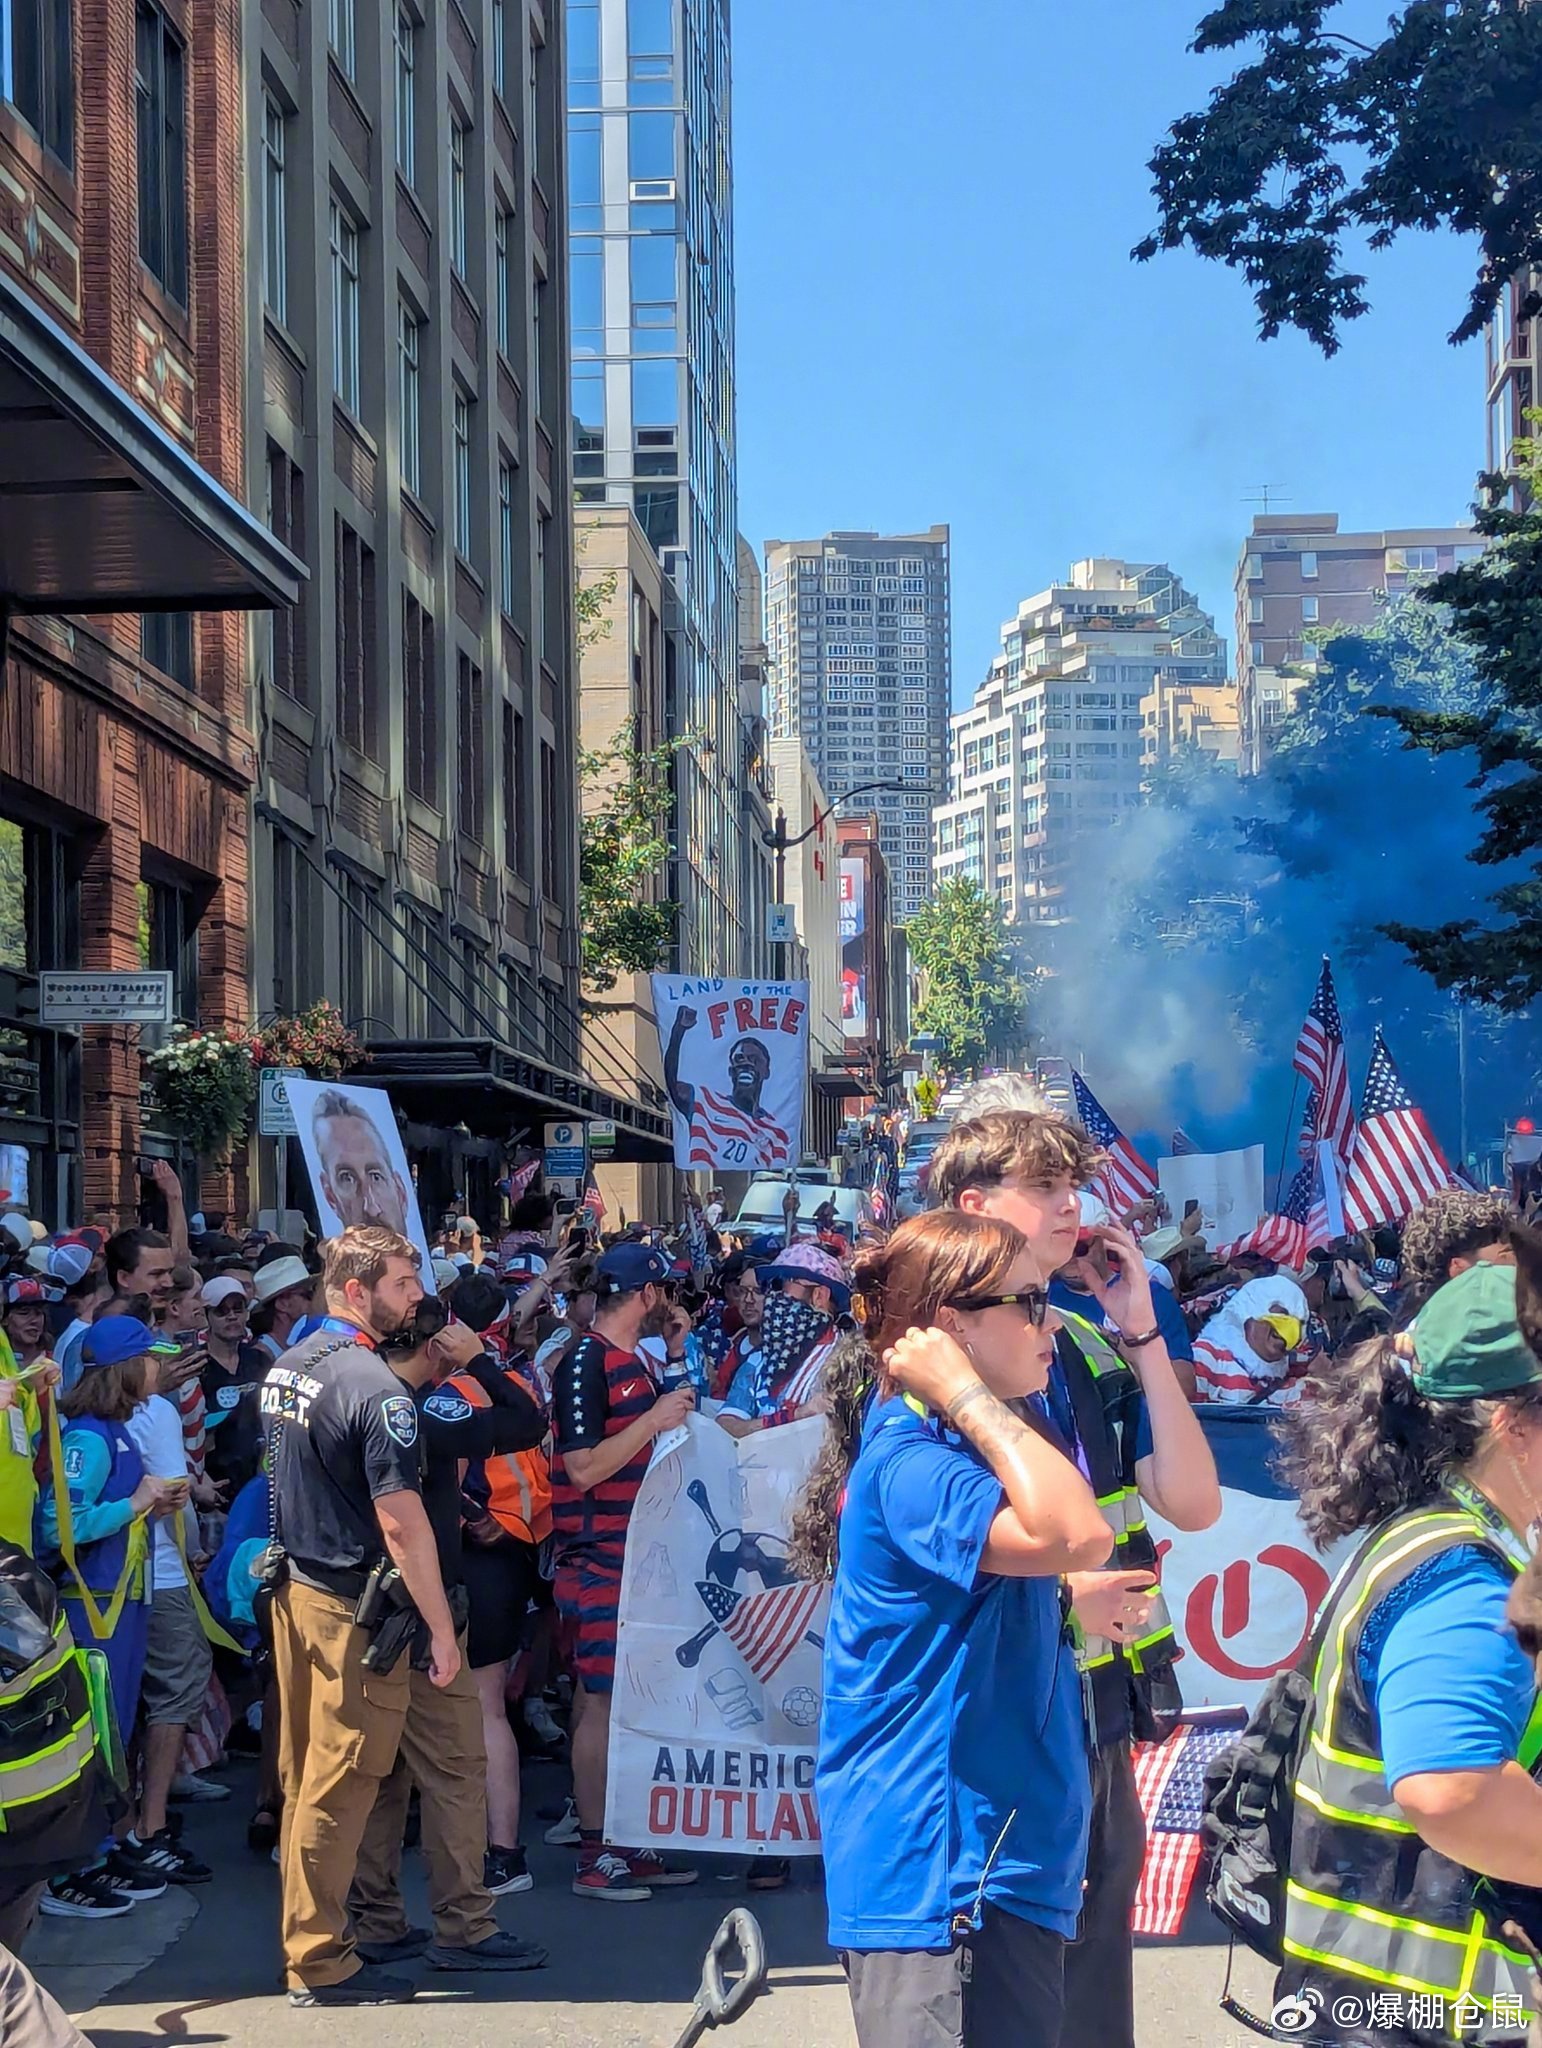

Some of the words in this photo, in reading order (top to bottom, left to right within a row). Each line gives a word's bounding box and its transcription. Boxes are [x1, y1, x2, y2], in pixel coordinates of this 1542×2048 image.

[668, 978, 724, 1000] LAND
[741, 985, 760, 996] OF
[766, 985, 792, 996] THE
[707, 997, 806, 1040] FREE
[559, 1128, 570, 1141] P
[723, 1138, 748, 1163] 20
[652, 1746, 816, 1788] AMERIC
